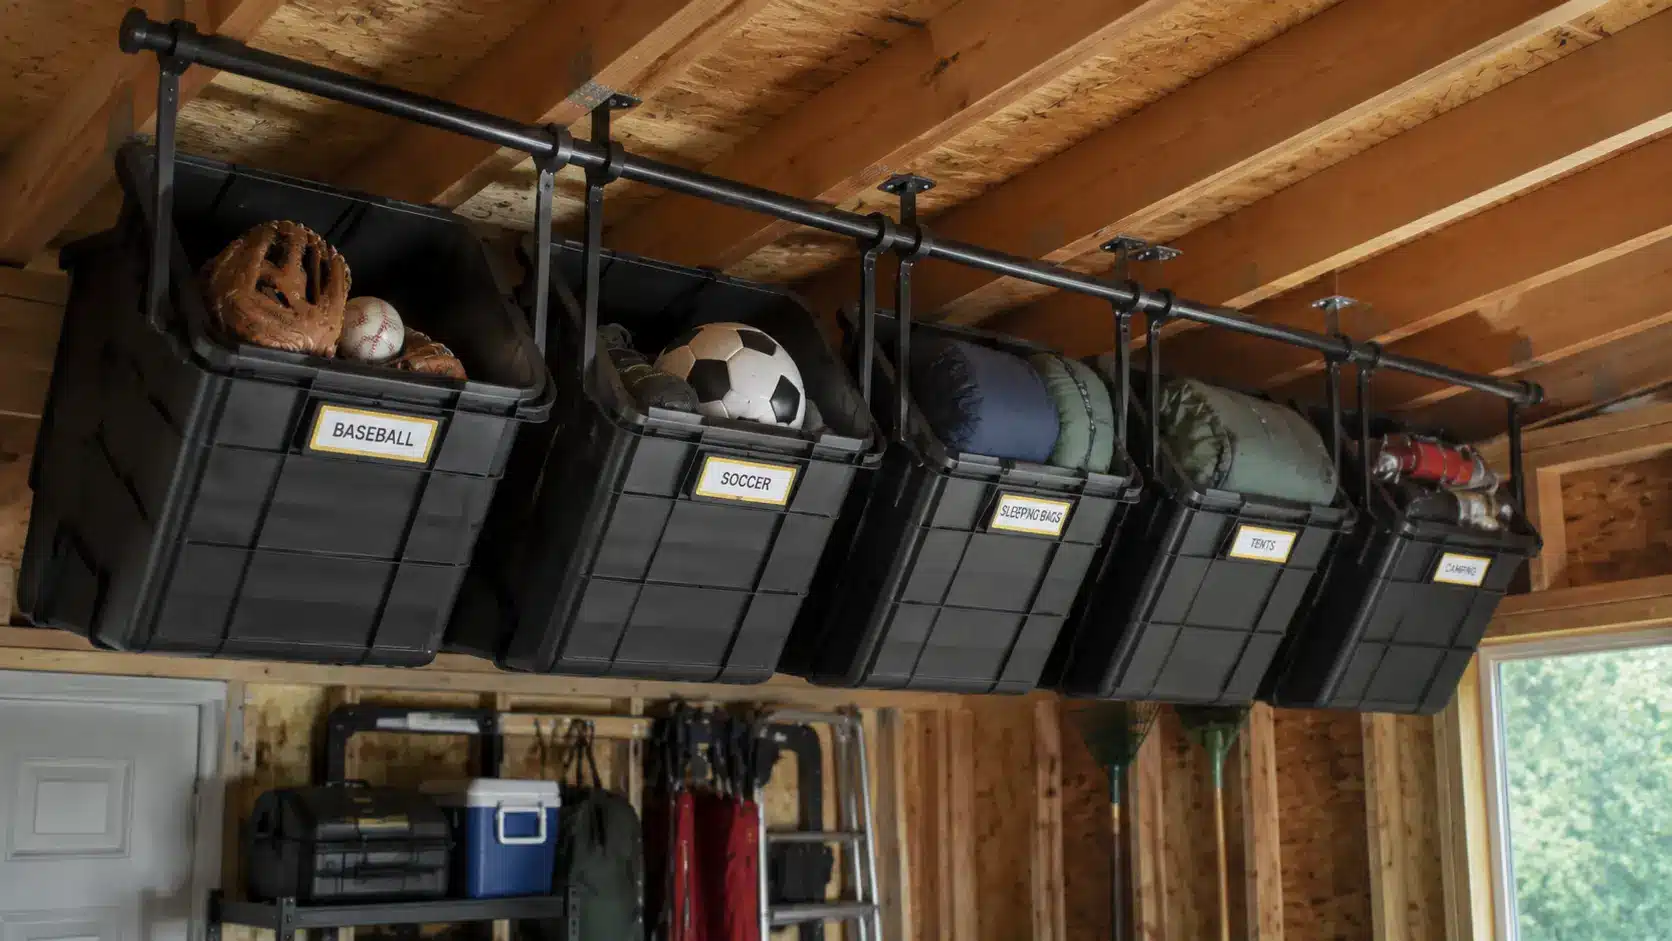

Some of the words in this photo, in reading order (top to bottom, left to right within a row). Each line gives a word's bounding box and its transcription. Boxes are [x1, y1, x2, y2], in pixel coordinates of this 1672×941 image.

[332, 422, 414, 447] BASEBALL
[720, 471, 772, 491] SOCCER
[1039, 509, 1063, 524] BAGS
[1250, 537, 1276, 551] TENTS
